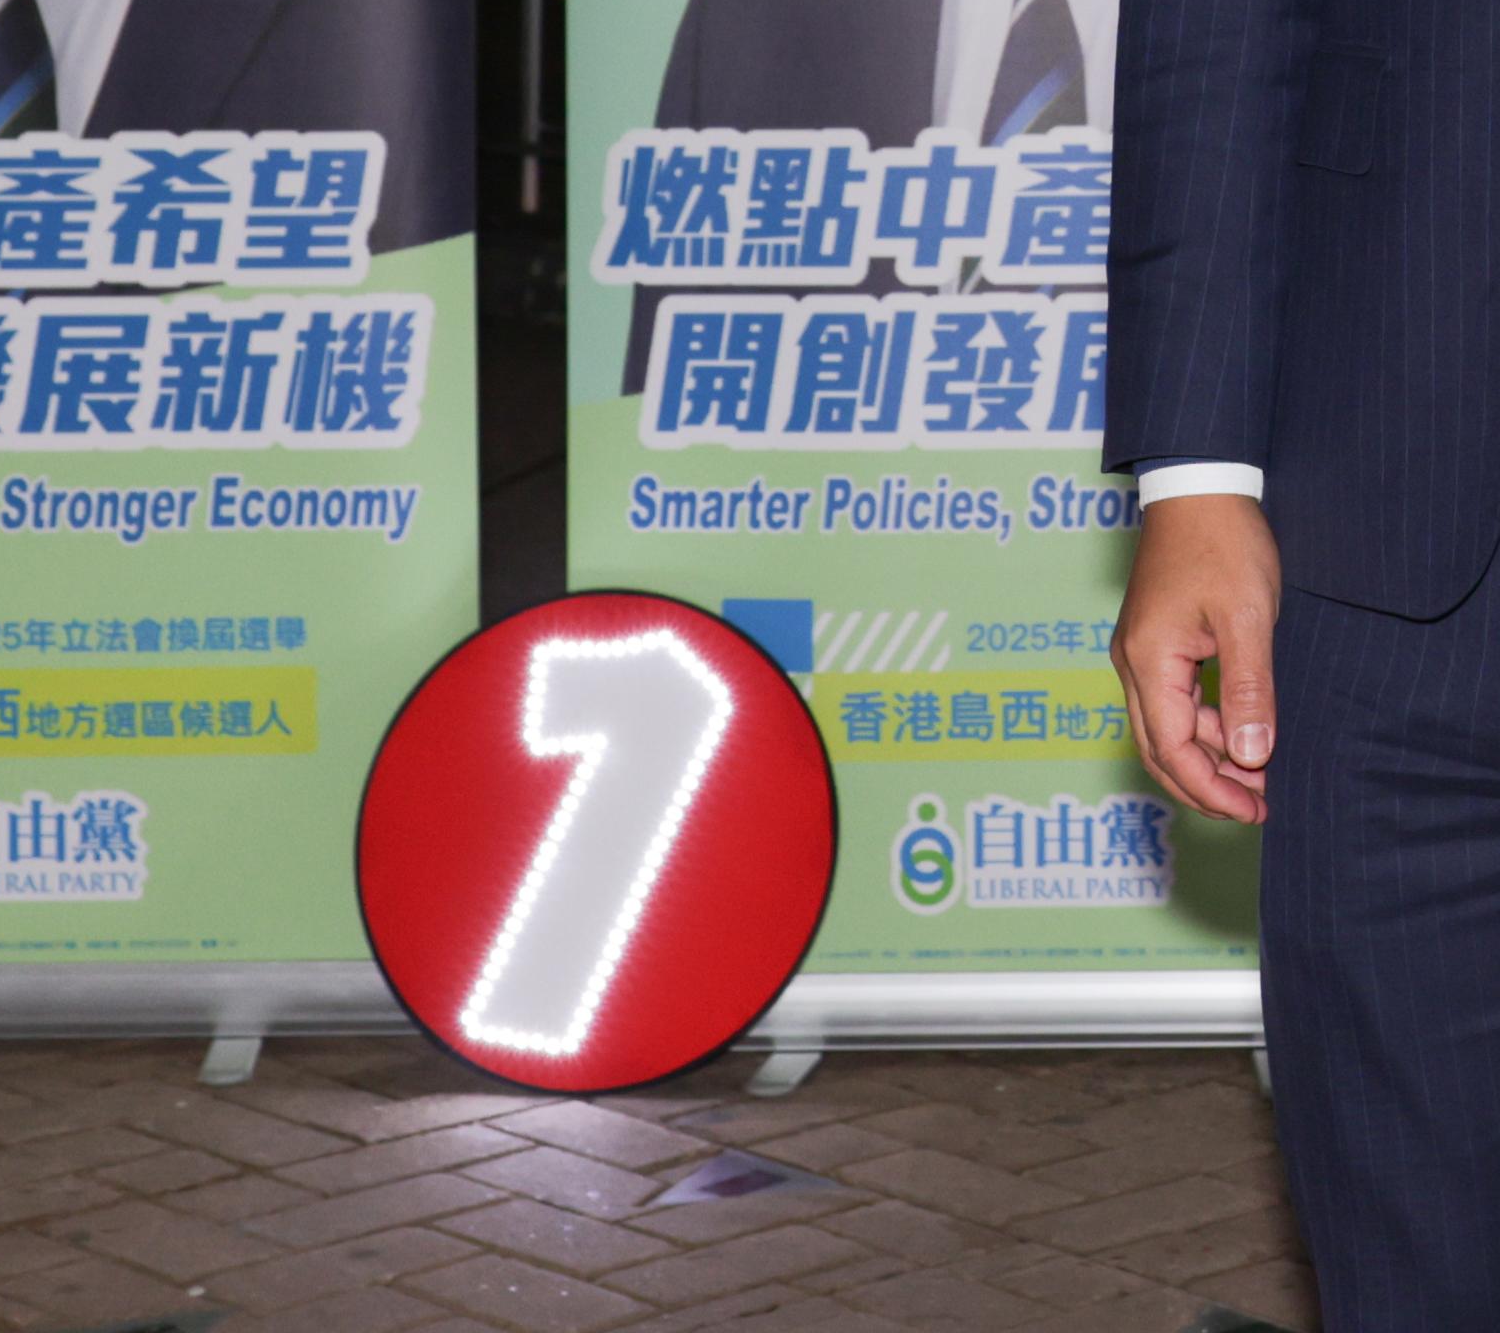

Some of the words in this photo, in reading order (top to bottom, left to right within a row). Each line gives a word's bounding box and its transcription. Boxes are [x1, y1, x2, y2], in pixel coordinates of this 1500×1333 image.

[606, 144, 1108, 267] 燃點中產
[0, 477, 196, 543] Stronger
[211, 478, 416, 540] Economy
[631, 477, 809, 529] Smarter
[825, 477, 1012, 544] Policies,
[460, 627, 734, 1054] 1
[973, 803, 1167, 868] 自由黨
[59, 871, 139, 895] PARTY
[975, 877, 1080, 900] LIBERAL
[1086, 876, 1167, 900] PARTY
